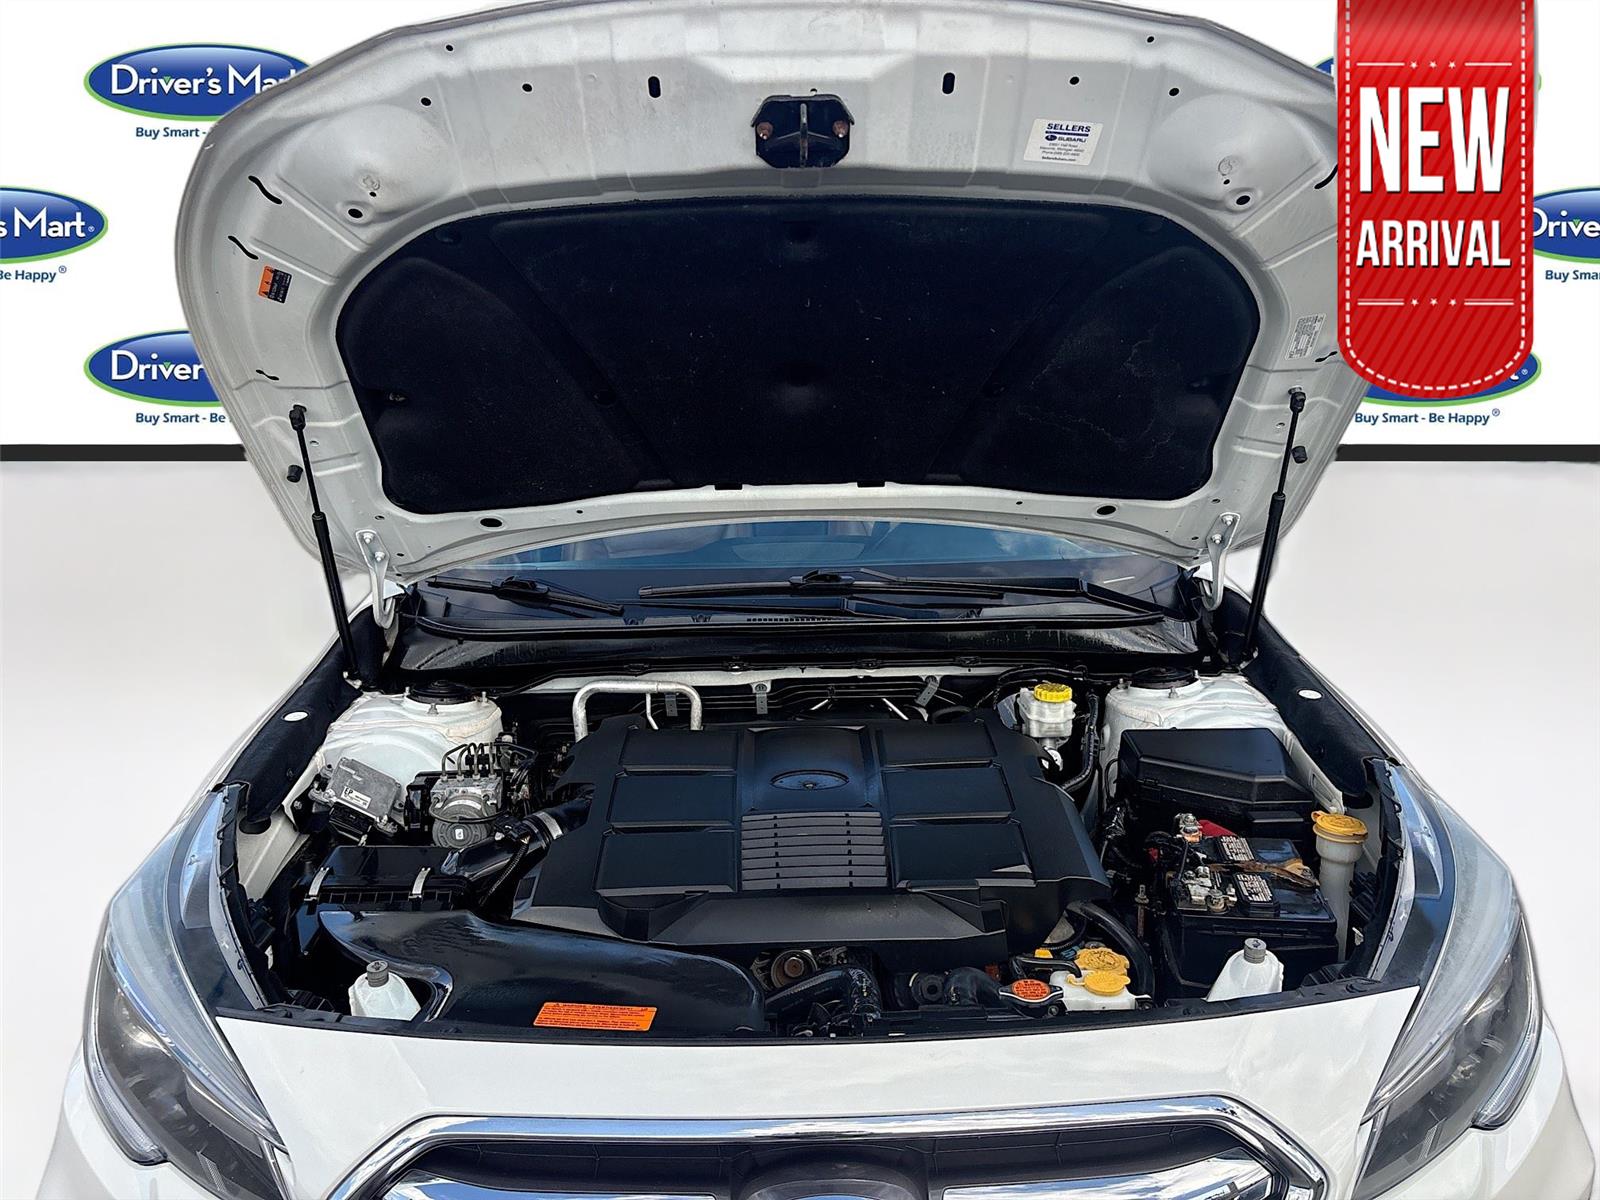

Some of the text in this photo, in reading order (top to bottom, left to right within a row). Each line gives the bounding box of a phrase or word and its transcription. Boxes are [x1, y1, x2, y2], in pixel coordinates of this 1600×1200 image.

[112, 63, 296, 94] Driver's Ma
[136, 127, 160, 140] Buy
[163, 127, 200, 137] Smart
[1046, 123, 1091, 132] SELLERS
[14, 206, 86, 237] Mart
[15, 270, 57, 283] Happy
[1545, 270, 1600, 283] Buy Sma
[136, 413, 160, 426] Buy
[163, 413, 200, 423] Smart
[210, 413, 226, 423] Be
[1355, 413, 1379, 426] Buy
[1382, 413, 1419, 423] Smart
[1429, 413, 1445, 423] Be
[1449, 413, 1490, 426] Happy
